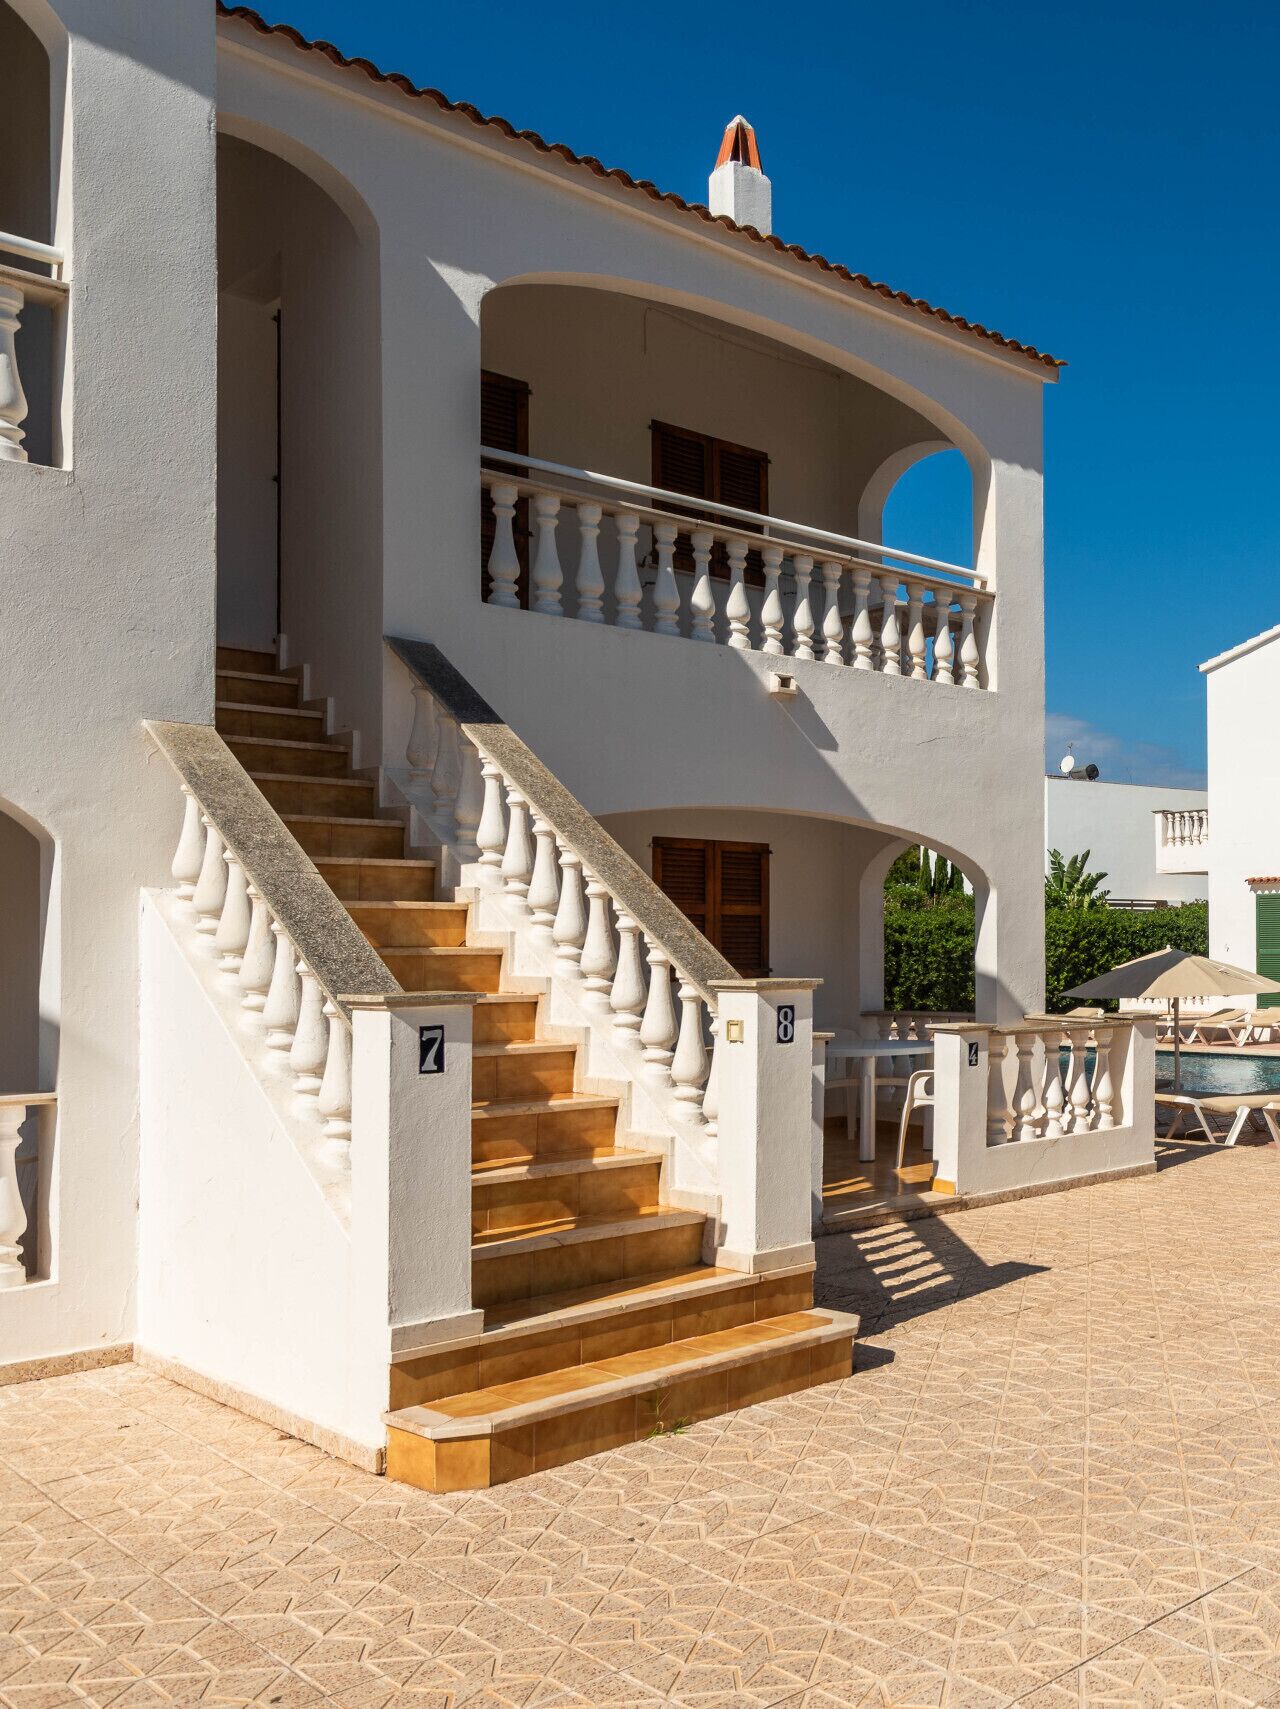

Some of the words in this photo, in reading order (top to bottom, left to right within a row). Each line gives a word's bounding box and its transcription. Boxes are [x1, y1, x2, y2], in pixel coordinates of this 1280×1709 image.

[778, 1007, 794, 1041] 8
[421, 1029, 443, 1072] 7
[969, 1042, 978, 1065] 4
